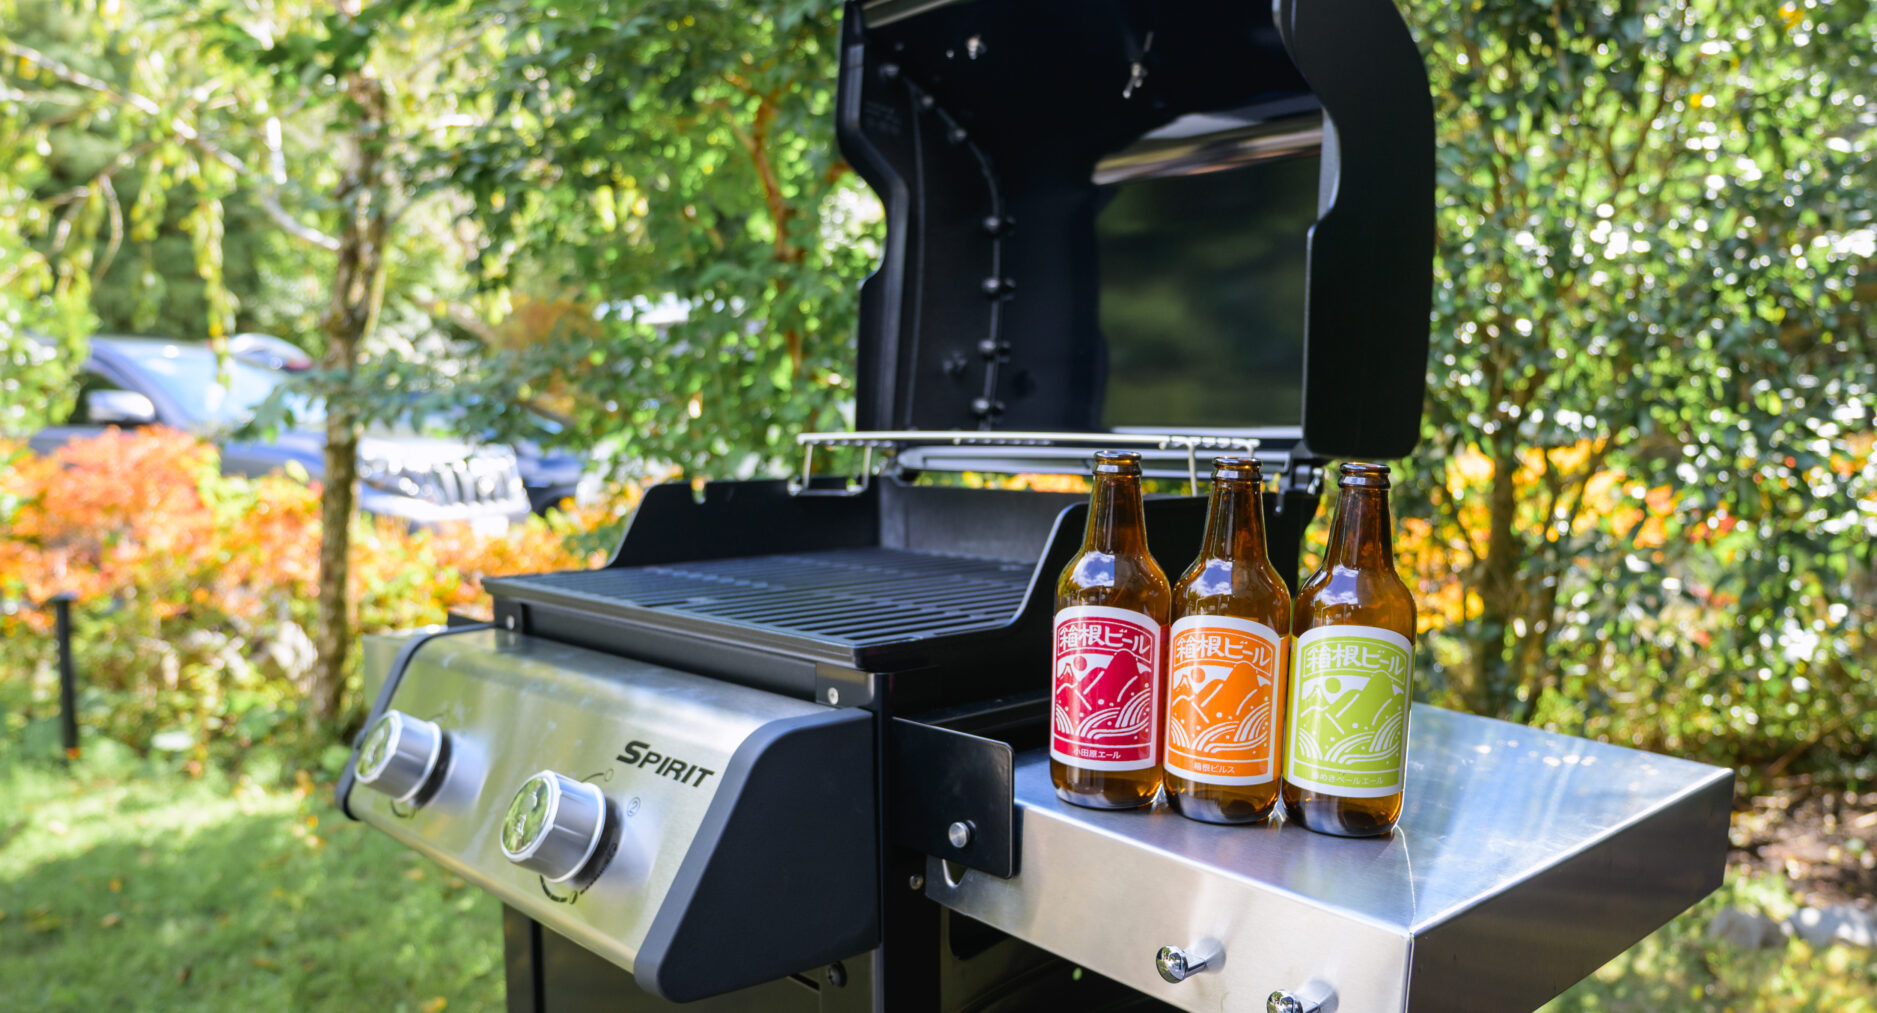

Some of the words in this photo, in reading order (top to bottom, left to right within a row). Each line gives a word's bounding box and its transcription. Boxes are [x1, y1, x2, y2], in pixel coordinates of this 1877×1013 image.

[1059, 624, 1151, 654] 箱根ビール
[1176, 634, 1271, 667] 箱根ビール
[1306, 644, 1405, 675] 箱根ビール
[616, 740, 715, 788] SPIRIT
[1312, 771, 1383, 785] めきペールエール
